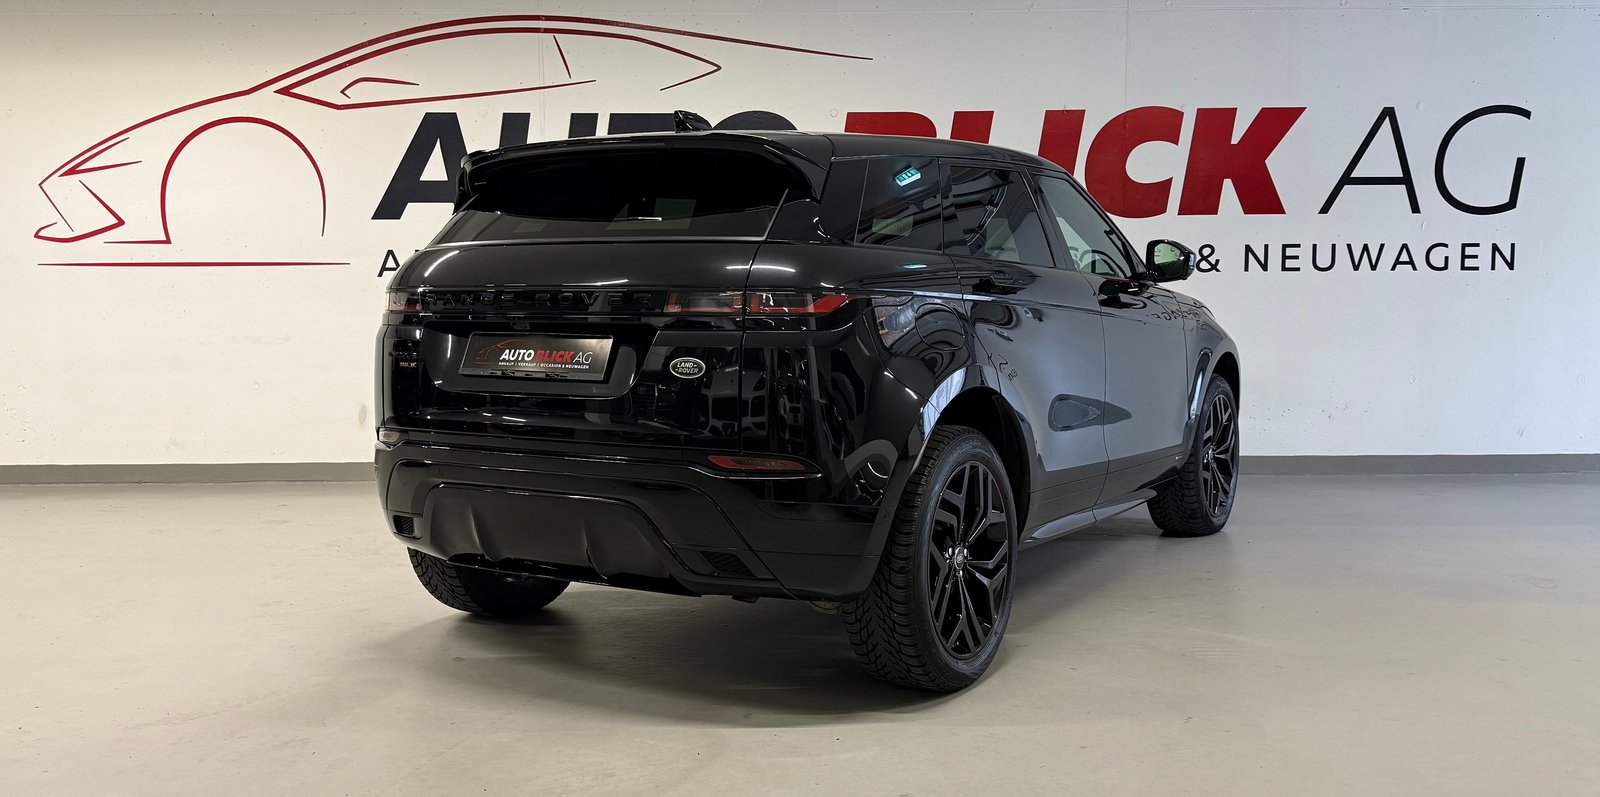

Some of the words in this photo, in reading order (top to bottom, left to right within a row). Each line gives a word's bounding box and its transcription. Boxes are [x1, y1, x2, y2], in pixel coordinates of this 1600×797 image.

[1318, 104, 1532, 216] AG
[1196, 243, 1221, 273] &
[1243, 242, 1517, 272] NEUWAGEN
[535, 292, 651, 307] ROVER
[499, 349, 535, 361] AUTO
[535, 349, 574, 363] BLICK
[573, 351, 593, 364] AG
